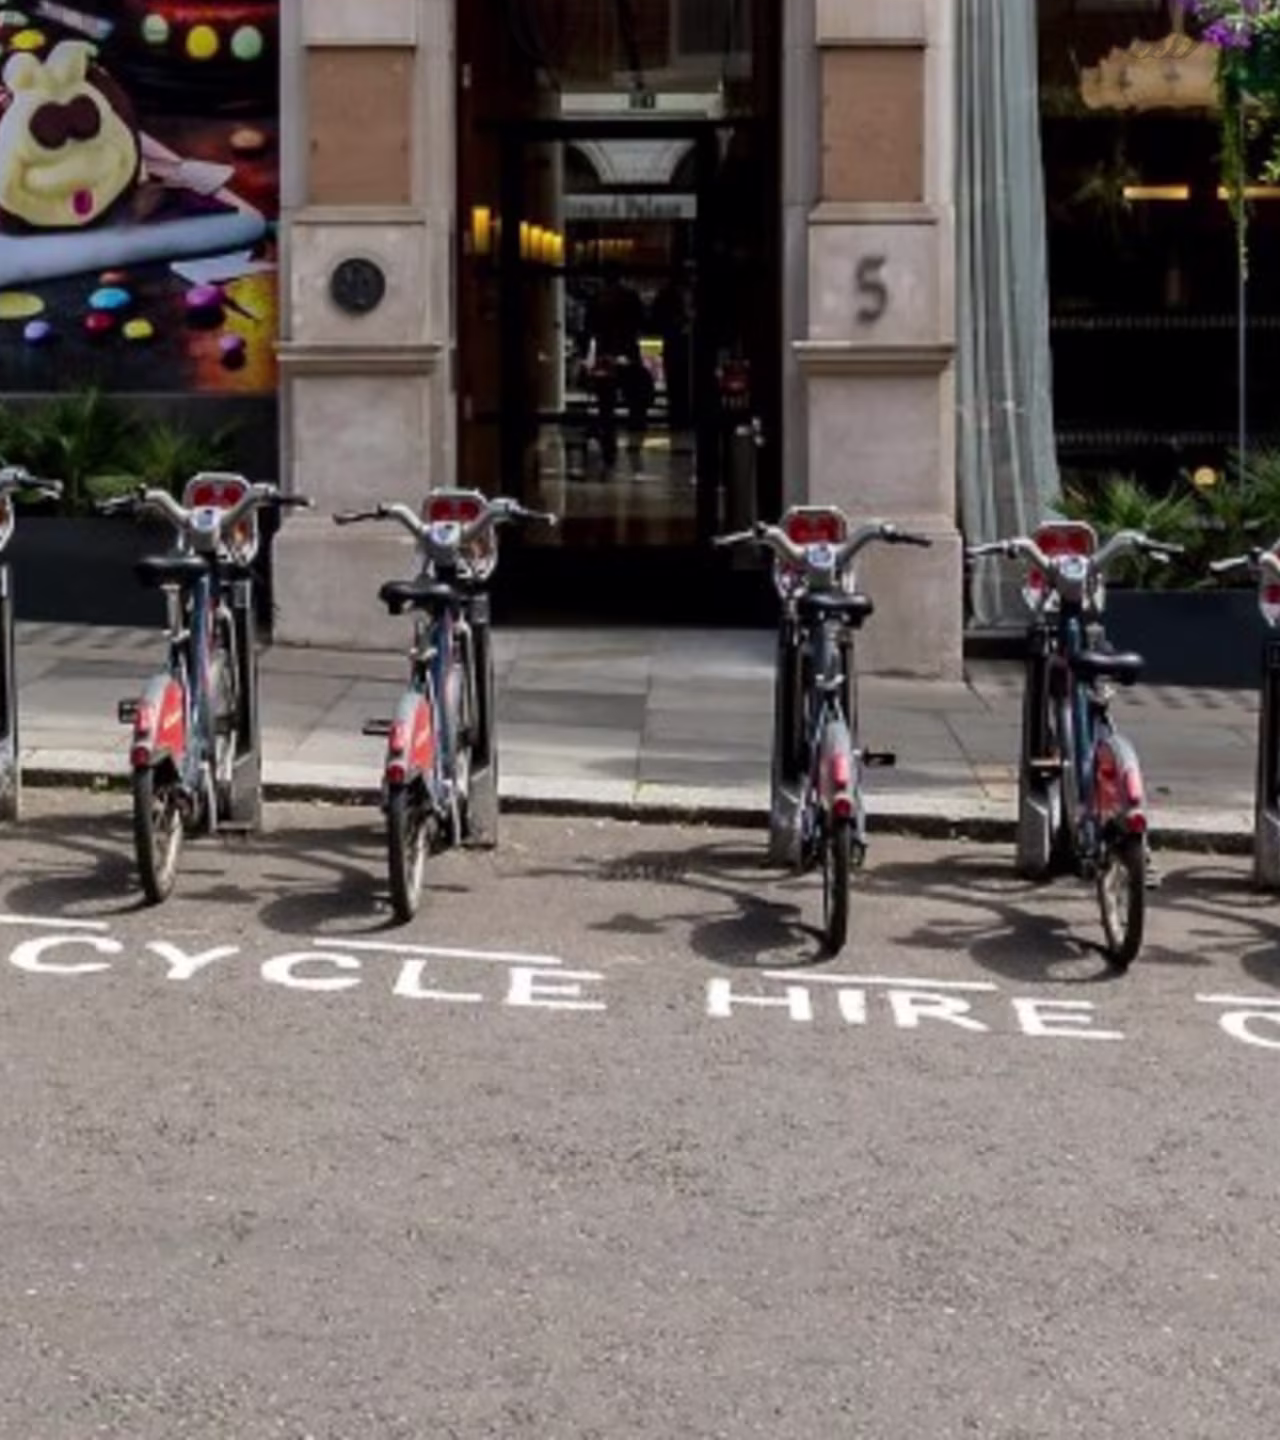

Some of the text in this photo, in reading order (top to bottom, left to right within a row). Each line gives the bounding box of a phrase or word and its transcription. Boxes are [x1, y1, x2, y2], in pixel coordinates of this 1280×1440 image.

[856, 255, 888, 326] 5
[8, 934, 607, 1010] CYCLE
[707, 978, 1124, 1040] HIRE
